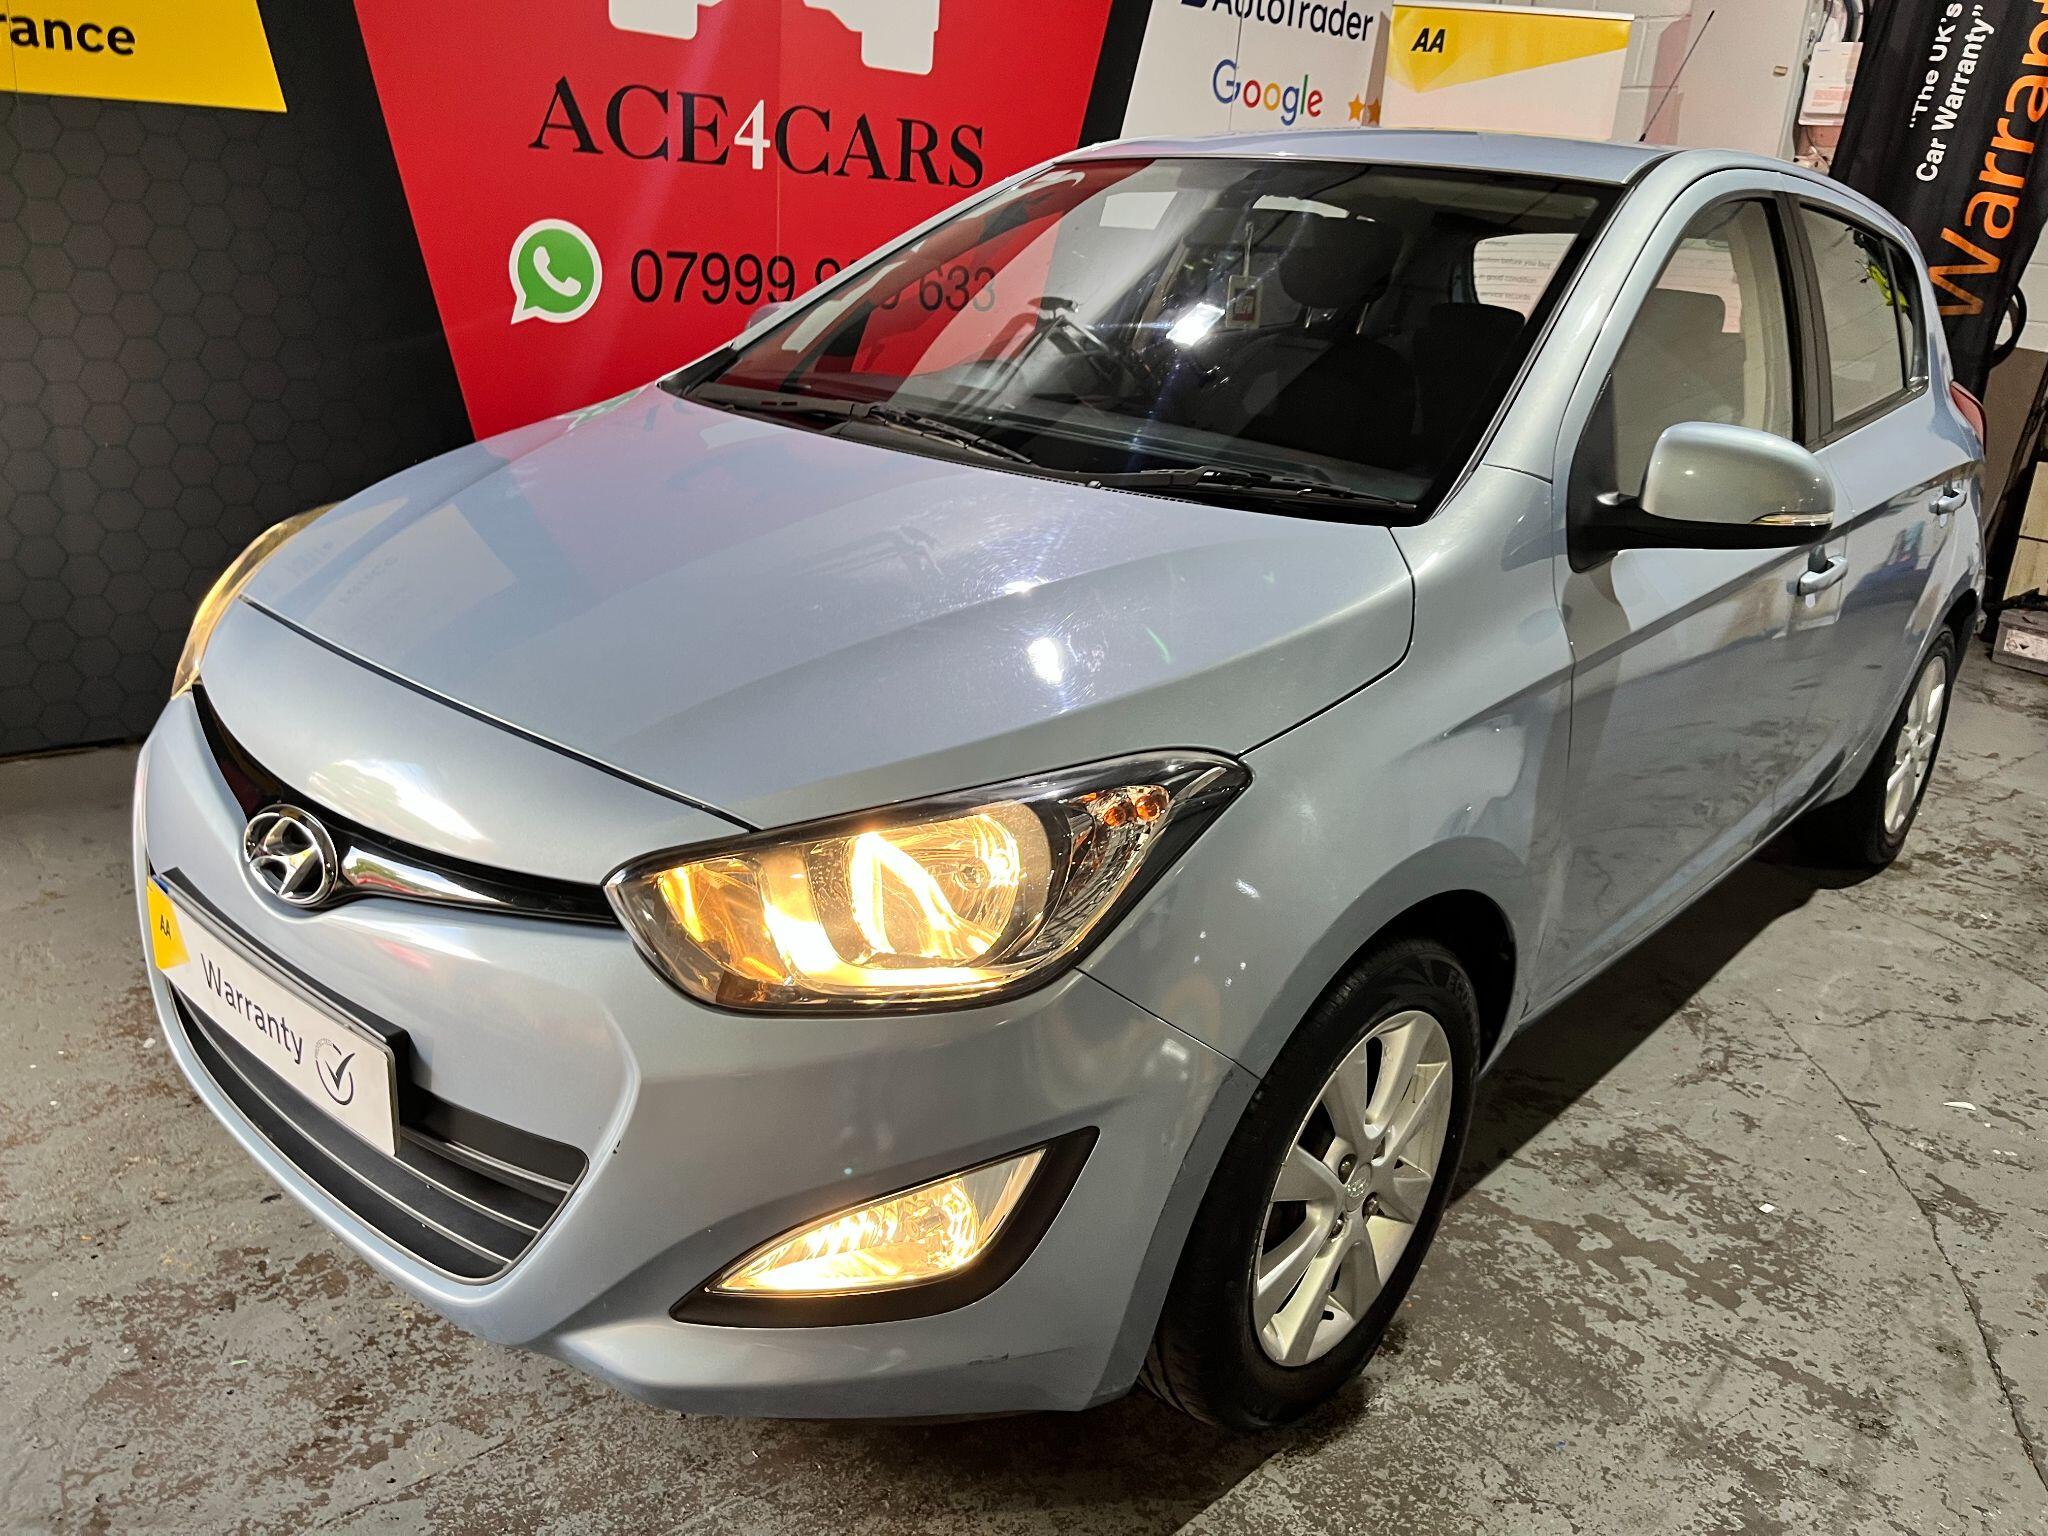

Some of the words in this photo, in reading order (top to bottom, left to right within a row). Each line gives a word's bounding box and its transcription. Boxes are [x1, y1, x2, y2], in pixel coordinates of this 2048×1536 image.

[1411, 28, 1446, 54] AA
[1212, 58, 1324, 126] Google
[528, 76, 985, 189] ACE4CARS
[1915, 138, 1947, 182] Car
[1928, 0, 2048, 317] Warran
[630, 248, 797, 306] 07999
[918, 265, 996, 312] 633
[159, 914, 172, 940] AA
[200, 952, 303, 1065] Warranty
